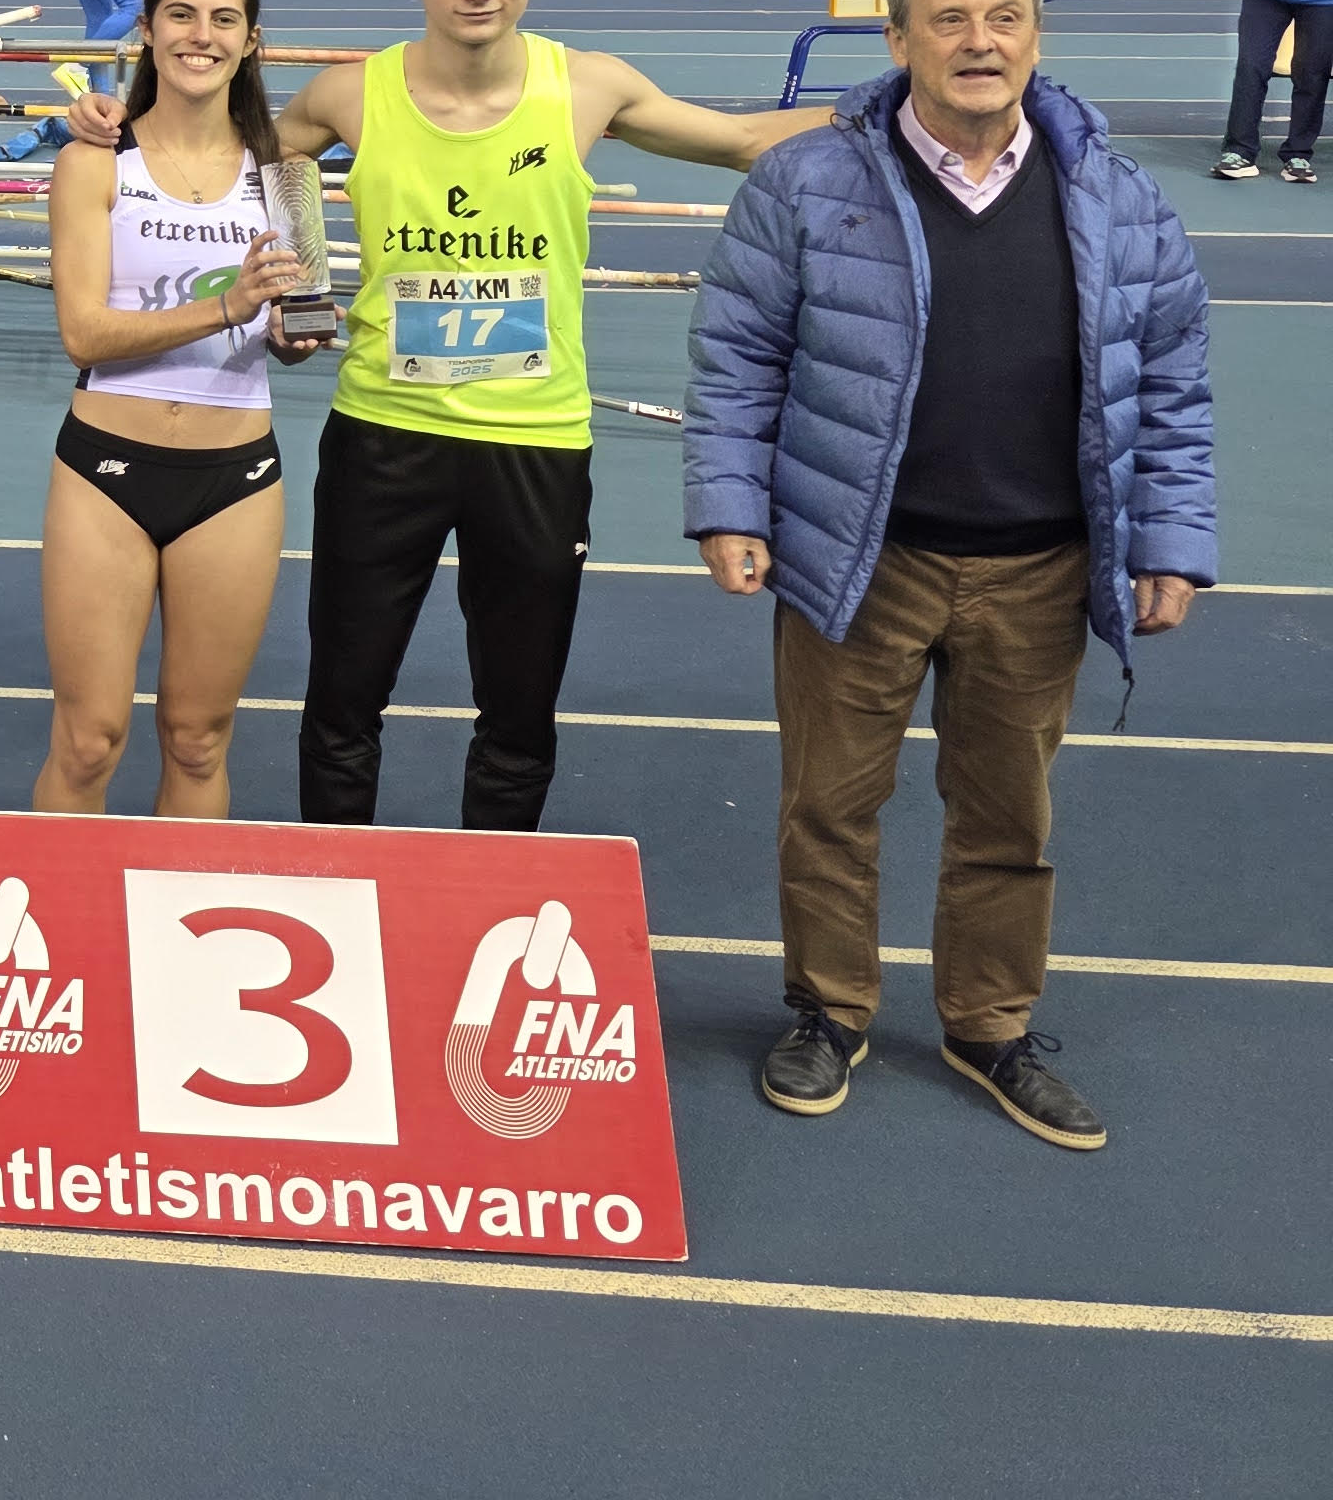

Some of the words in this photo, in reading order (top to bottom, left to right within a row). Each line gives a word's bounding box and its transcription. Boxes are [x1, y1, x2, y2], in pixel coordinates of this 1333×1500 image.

[428, 278, 510, 300] A4XKM
[437, 308, 505, 347] 17
[450, 364, 493, 377] 2025
[178, 906, 352, 1108] 3
[513, 1000, 636, 1059] FNA
[504, 1055, 636, 1083] ATLETISMO
